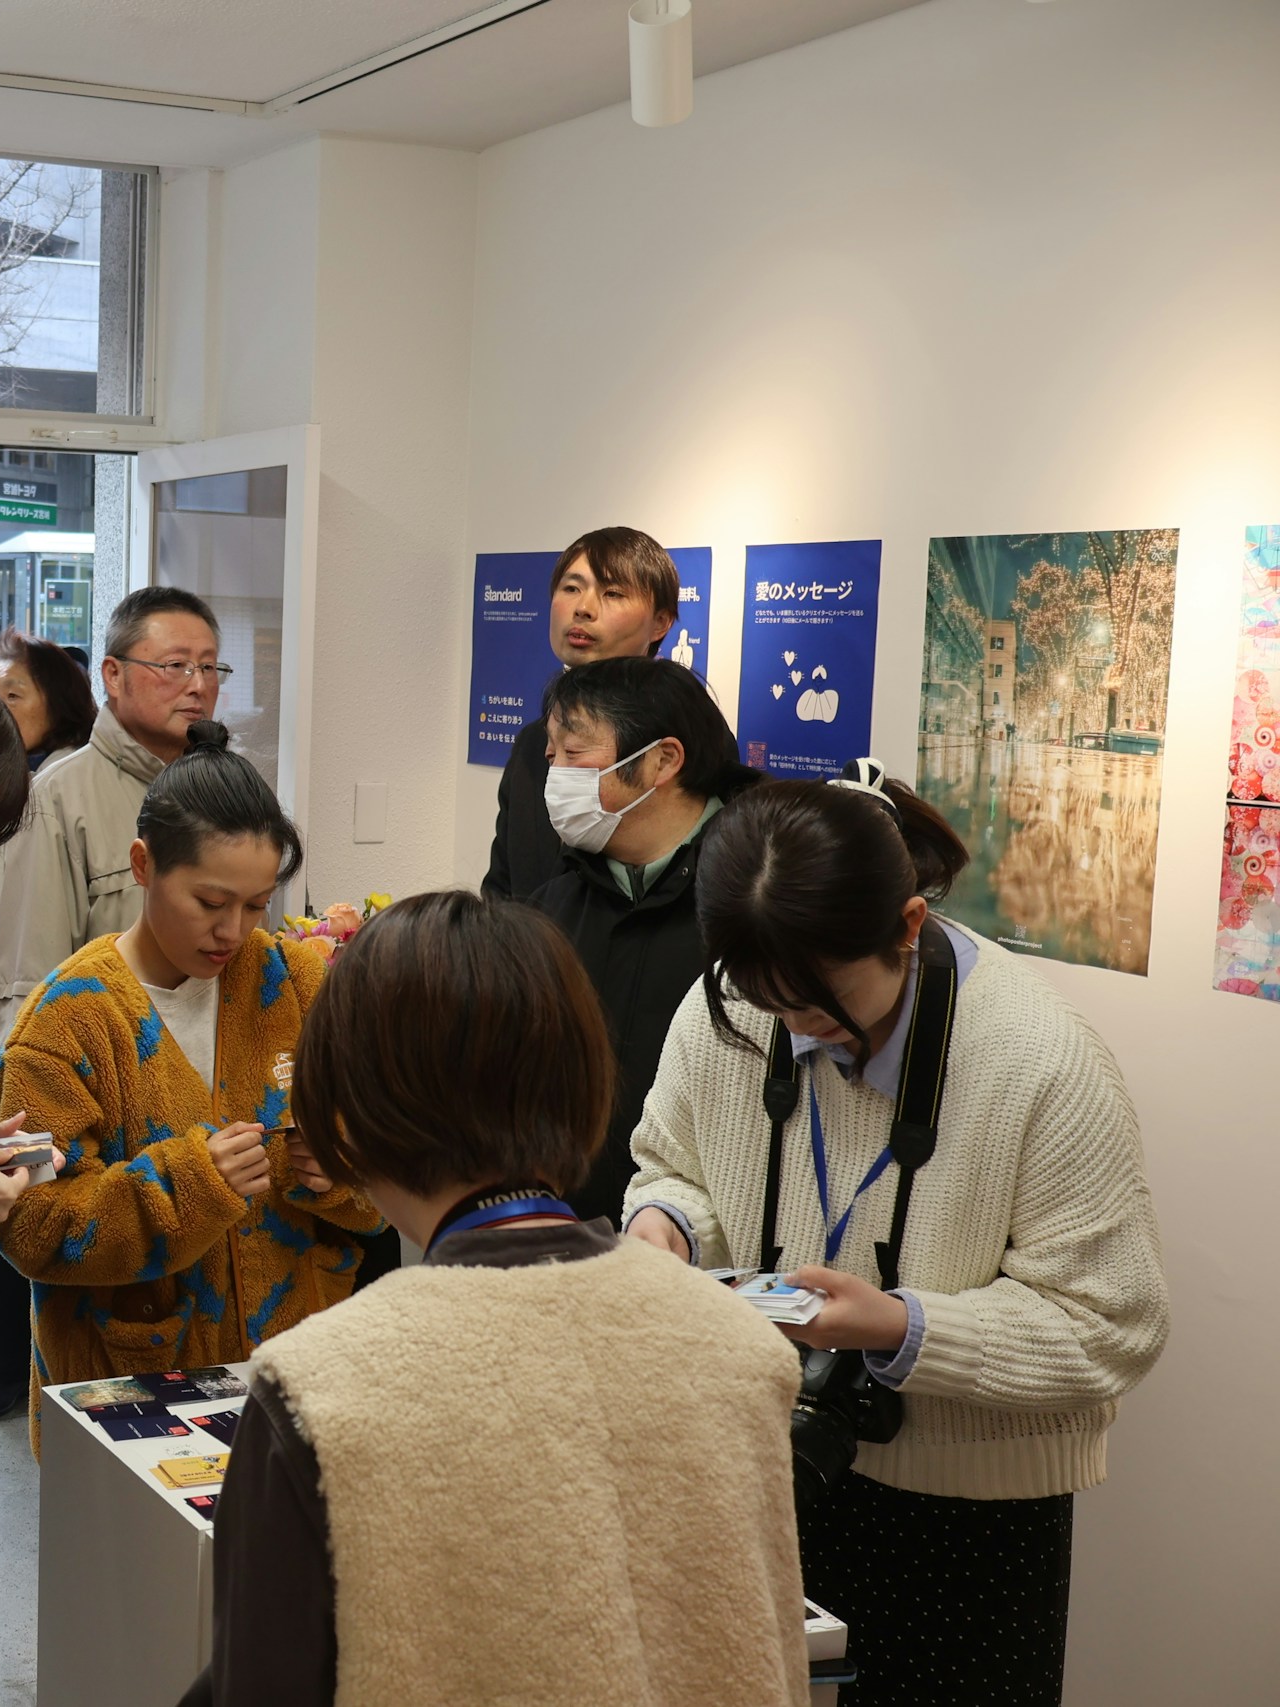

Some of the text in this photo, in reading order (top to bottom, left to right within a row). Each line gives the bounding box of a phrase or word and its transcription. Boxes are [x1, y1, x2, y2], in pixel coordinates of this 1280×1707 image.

[484, 588, 522, 602] standard
[755, 580, 853, 602] 愛のメッセージ
[488, 696, 524, 706] ちがいを楽しむ
[487, 714, 523, 725] こえに寄り添う
